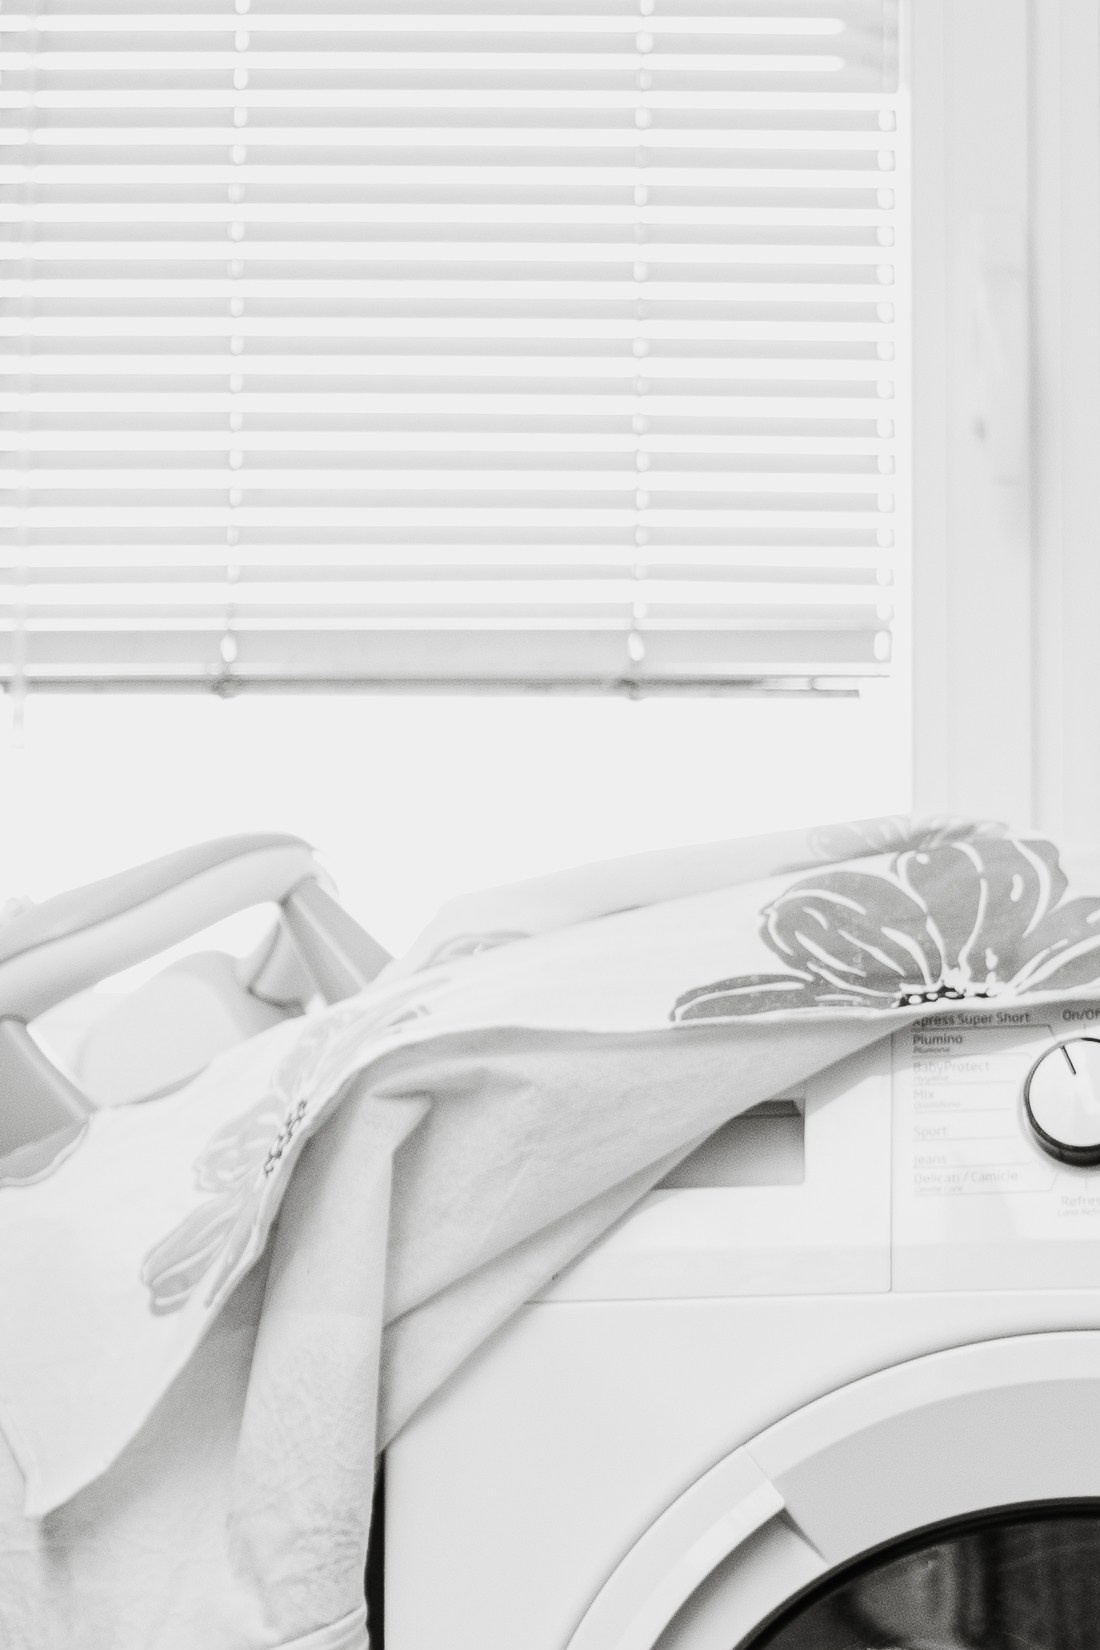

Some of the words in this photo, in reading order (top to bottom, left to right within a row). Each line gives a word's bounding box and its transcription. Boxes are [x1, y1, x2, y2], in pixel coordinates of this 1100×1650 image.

[958, 1012, 993, 1026] Super
[996, 1011, 1031, 1024] Short
[913, 1089, 935, 1099] Mix
[914, 1125, 947, 1138] Sport
[914, 1173, 960, 1185] Delicati
[970, 1170, 1019, 1183] Camicie
